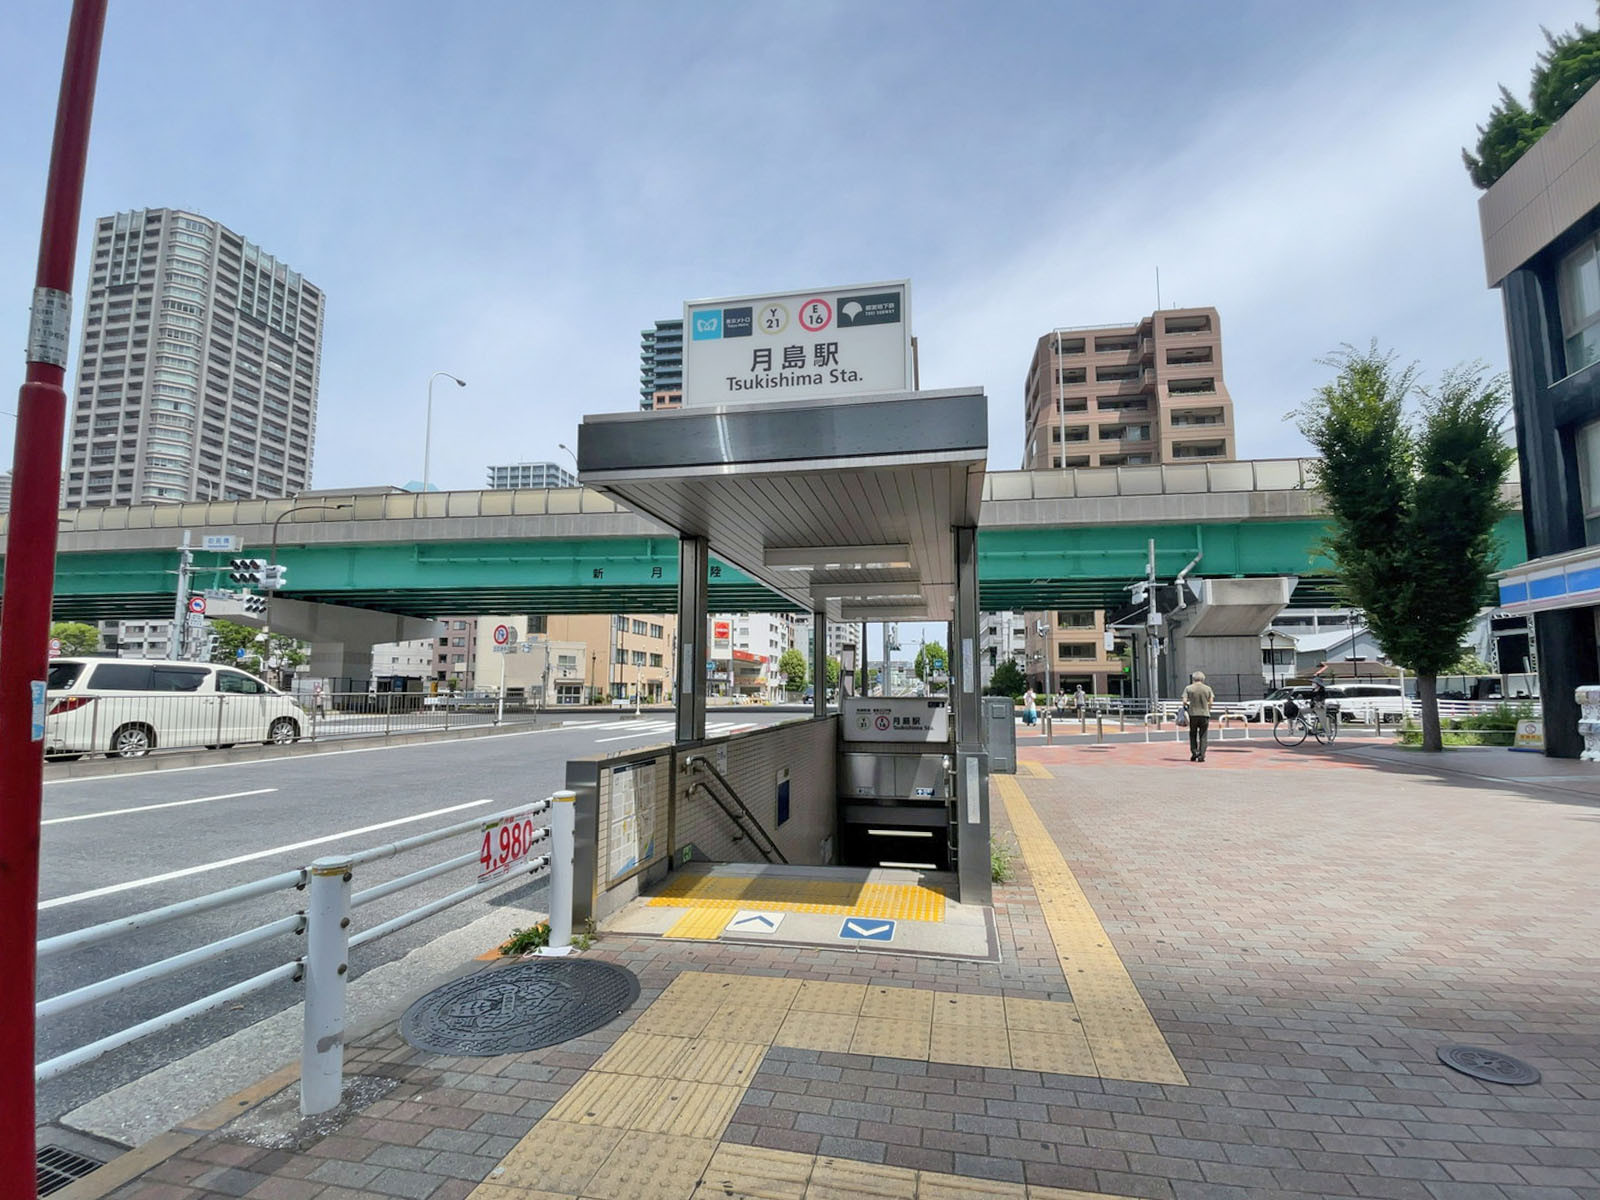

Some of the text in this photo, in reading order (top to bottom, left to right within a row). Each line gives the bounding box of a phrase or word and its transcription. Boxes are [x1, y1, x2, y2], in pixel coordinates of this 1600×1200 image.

[770, 308, 777, 317] Y
[812, 305, 818, 314] E
[766, 319, 780, 328] 21
[808, 314, 824, 325] 16
[750, 341, 839, 372] 月島駅
[726, 368, 863, 391] Tsukishima Sta.
